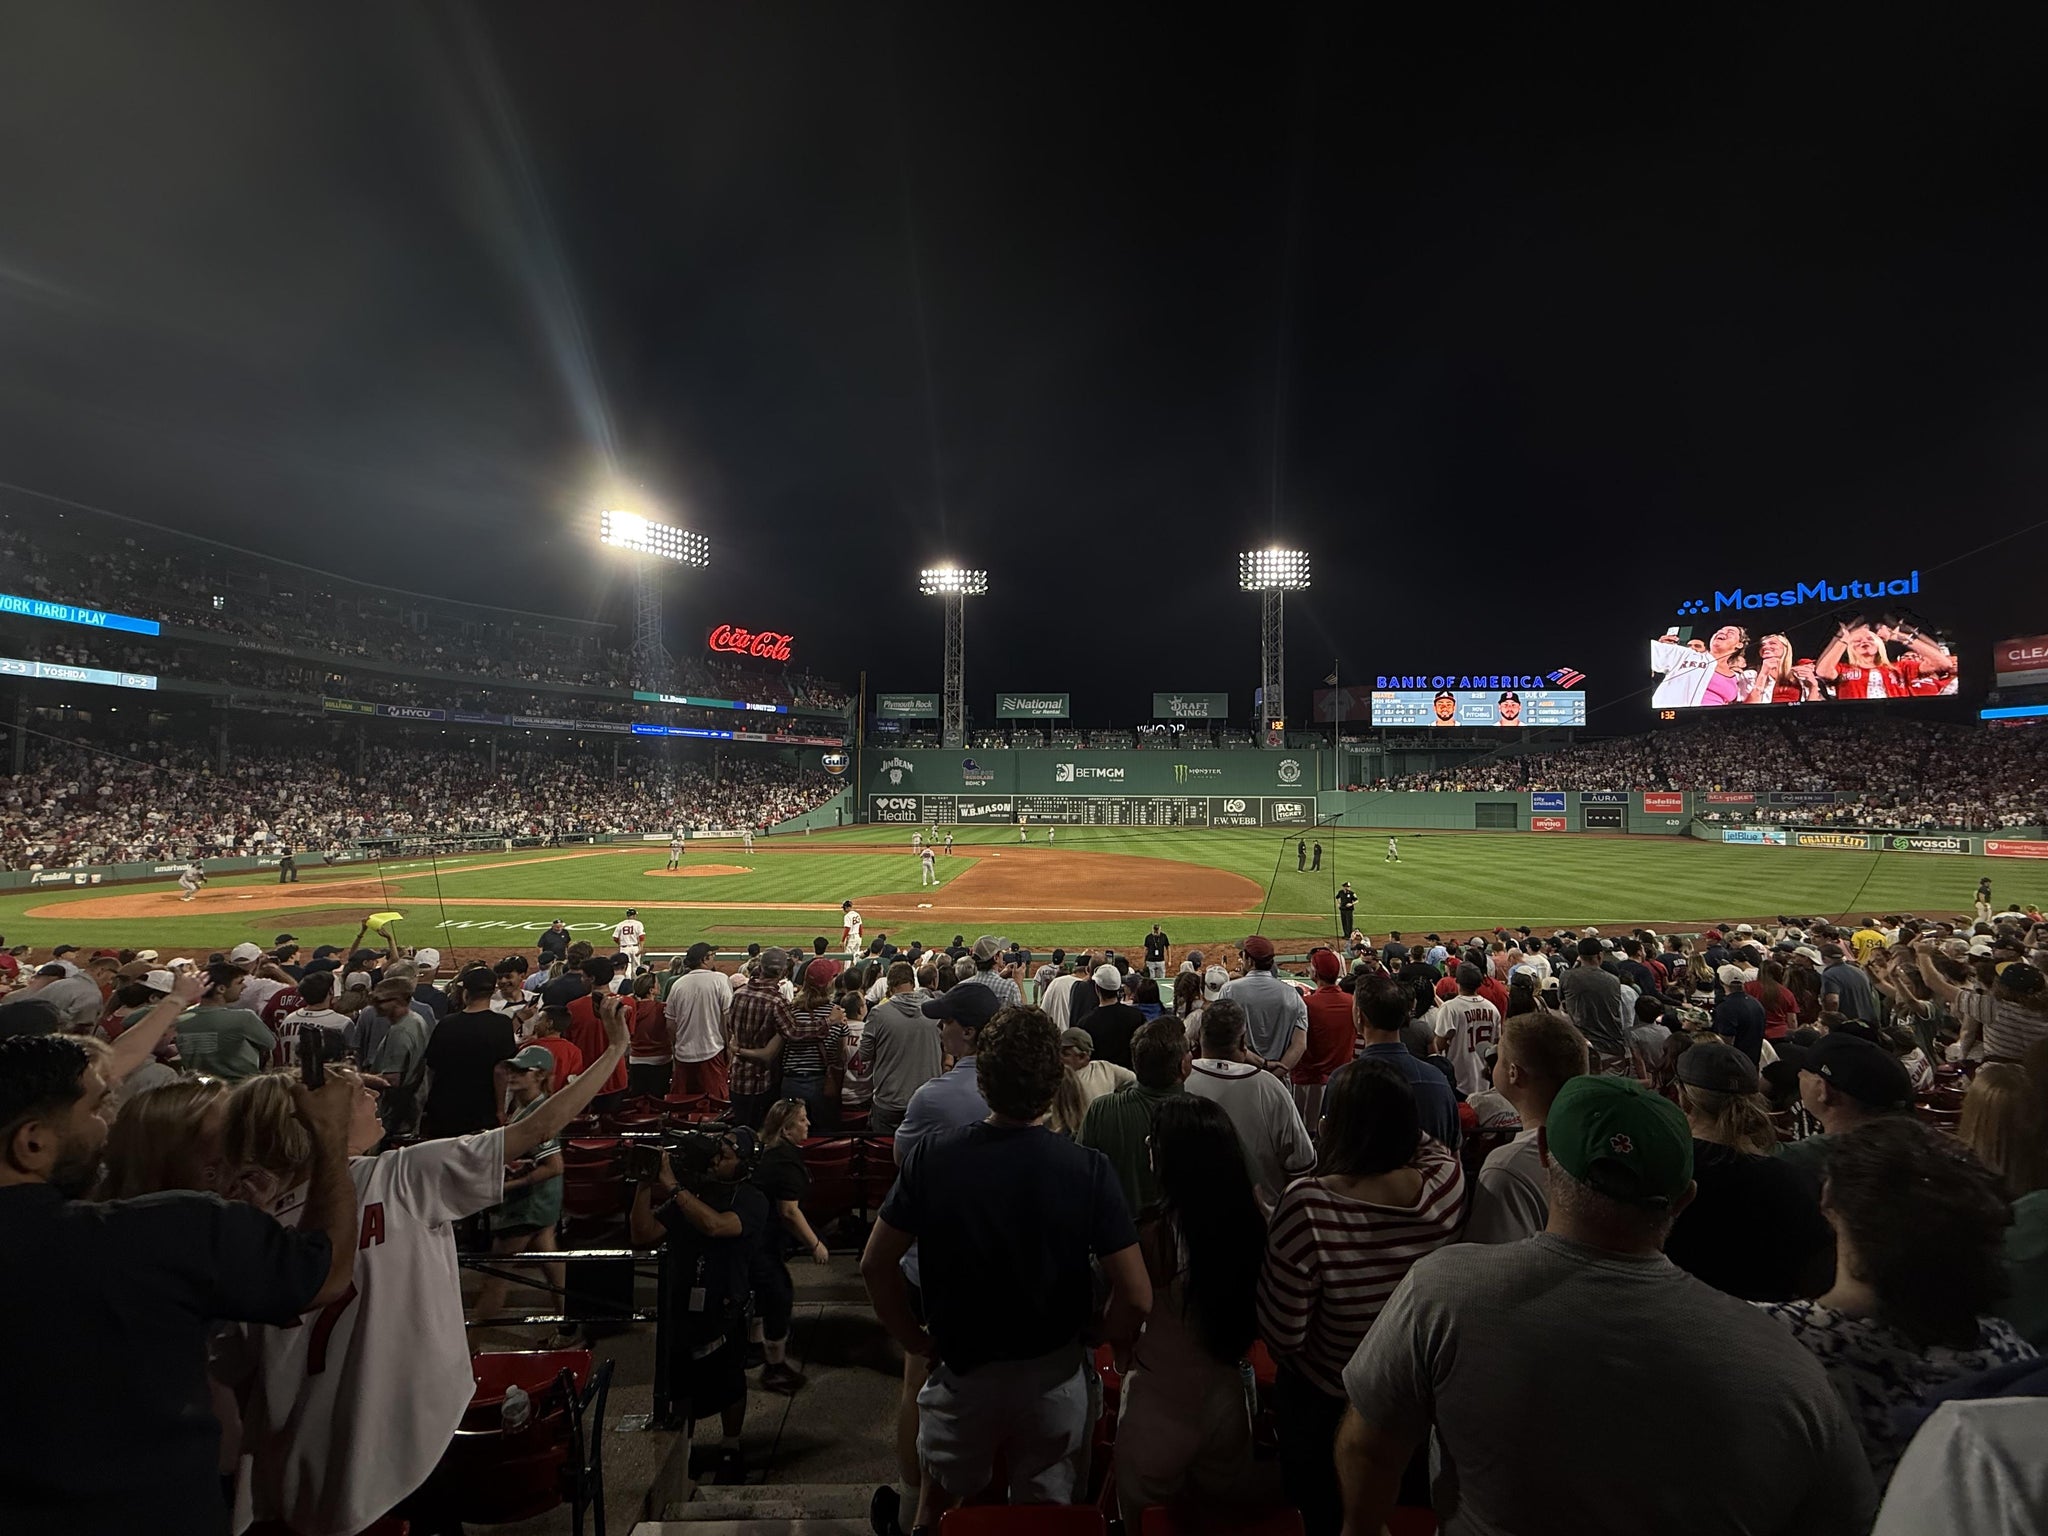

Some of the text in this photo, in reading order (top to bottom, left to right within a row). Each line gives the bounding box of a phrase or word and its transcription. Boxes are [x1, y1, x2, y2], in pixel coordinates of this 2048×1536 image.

[1714, 570, 1918, 611] MassMutual
[34, 603, 67, 619] HARD
[78, 611, 106, 625] PLAY
[709, 624, 794, 660] Coca-Cola
[2, 662, 148, 687] 2-3 YOSHIDA 0-2
[1376, 675, 1544, 688] BANK OF AMERICA
[883, 700, 932, 709] Plymouth Rock
[1016, 698, 1062, 709] National
[1171, 701, 1208, 711] DRAFT
[401, 709, 430, 717] HYCU
[1175, 709, 1208, 717] KINGS
[823, 756, 848, 766] Gulf
[880, 757, 913, 772] JIM BEAM
[1076, 768, 1124, 778] BETMGM
[889, 798, 917, 809] CVS
[1278, 803, 1302, 812] ACE
[878, 810, 917, 821] Health
[1229, 817, 1256, 825] WEBB
[1727, 832, 1758, 841] jetBlue
[1799, 835, 1841, 845] GRANITE
[1843, 836, 1866, 848] CITY
[1911, 839, 1960, 849] wasabi
[31, 872, 72, 884] Franklin
[622, 925, 634, 935] 81
[1866, 939, 1883, 948] 34
[280, 995, 304, 1007] ORTIZ
[1464, 1008, 1494, 1023] DURAN
[1467, 1026, 1493, 1053] 16
